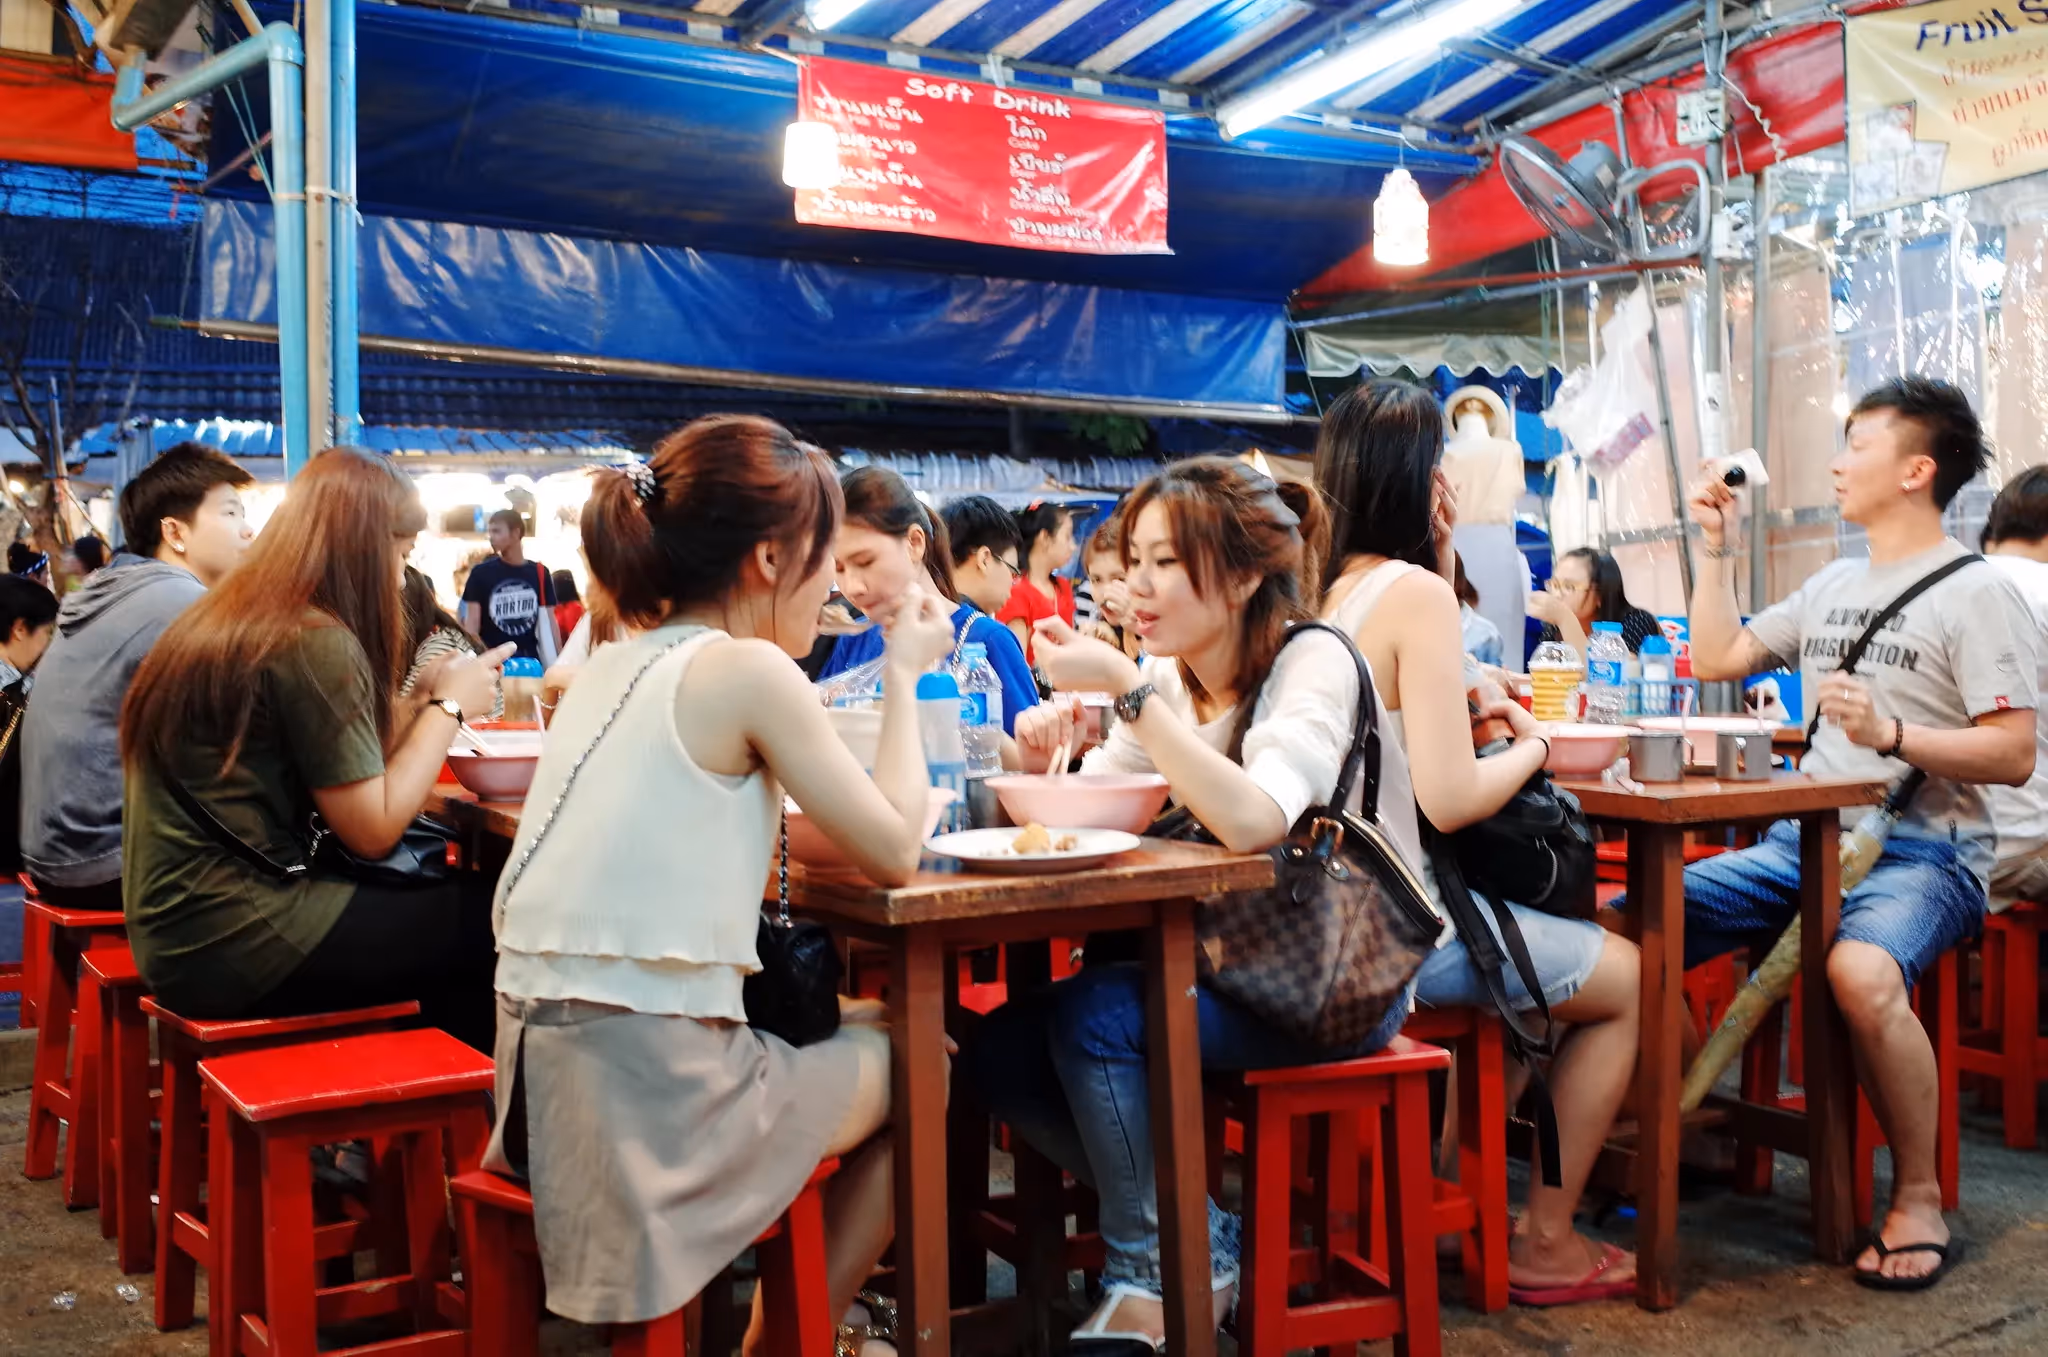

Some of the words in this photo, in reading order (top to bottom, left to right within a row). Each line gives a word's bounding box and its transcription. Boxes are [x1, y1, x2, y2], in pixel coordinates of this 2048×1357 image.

[1916, 7, 2018, 51] Fruit
[905, 77, 974, 104] Soft
[993, 88, 1071, 119] Drink
